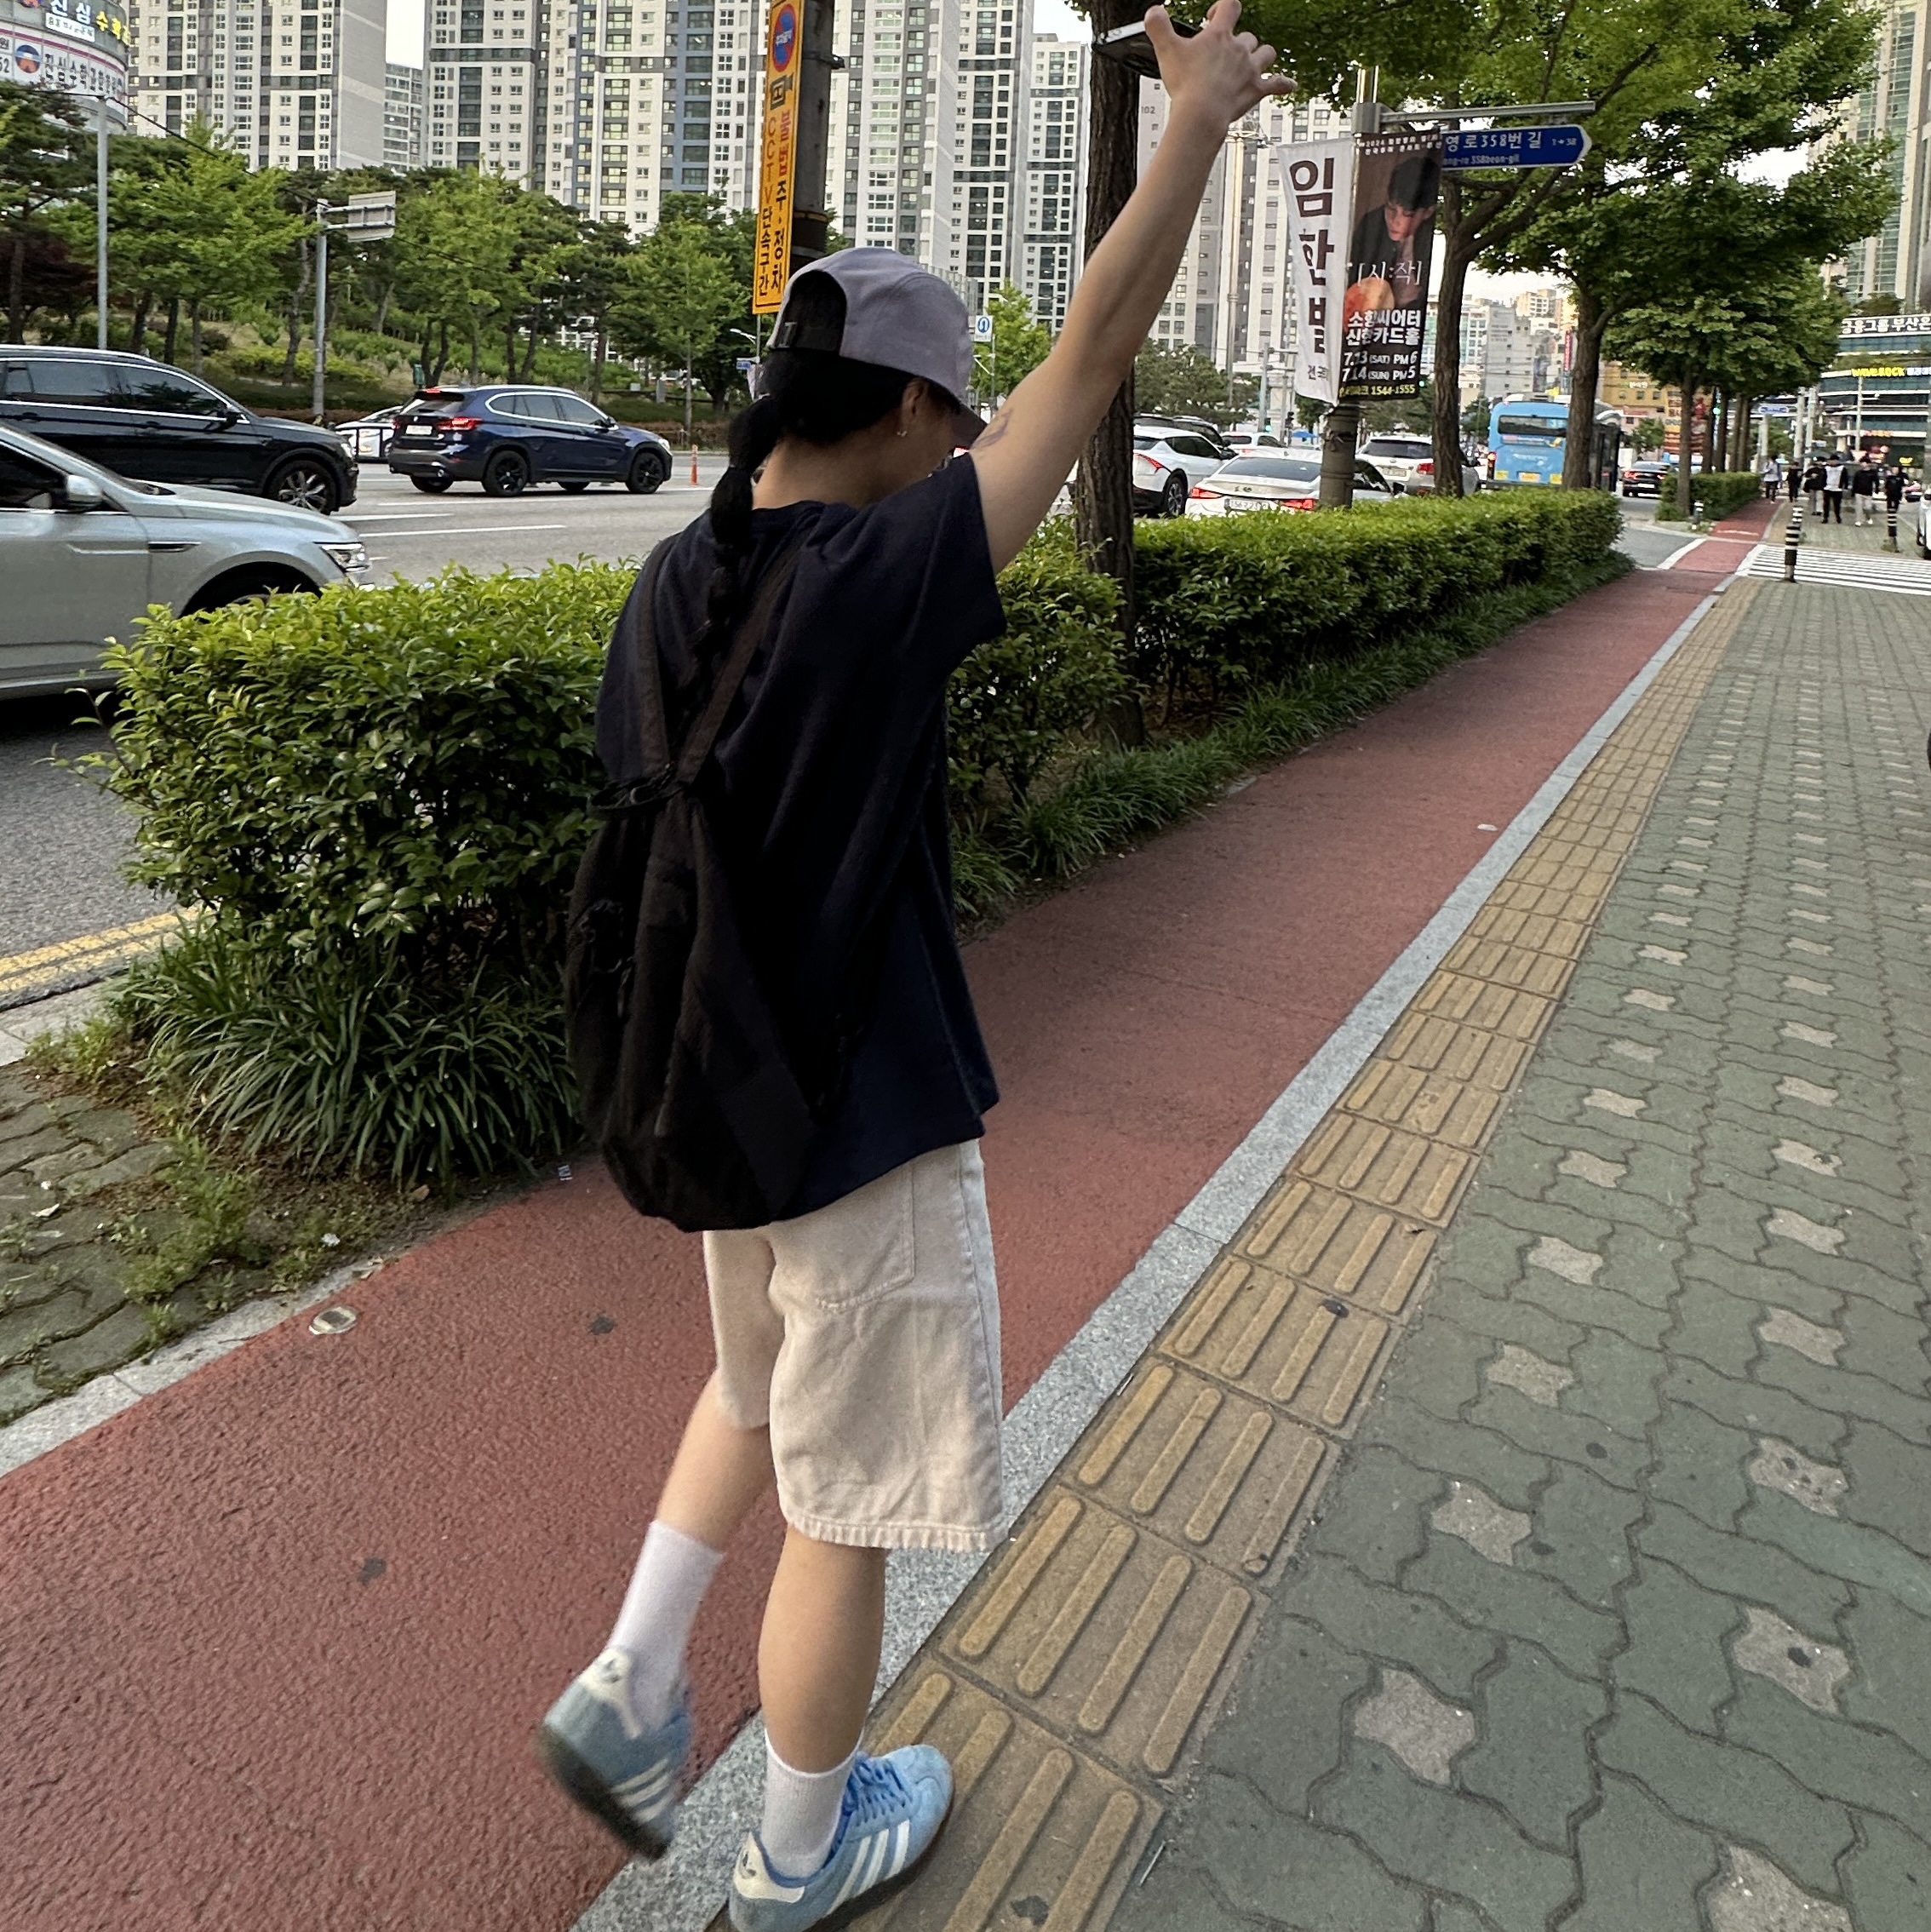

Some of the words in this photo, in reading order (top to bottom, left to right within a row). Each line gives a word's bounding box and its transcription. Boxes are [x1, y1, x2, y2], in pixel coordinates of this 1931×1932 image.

[1141, 106, 1155, 114] 102
[1446, 131, 1542, 152] 영로358번길
[1348, 309, 1421, 327] 소향씨어터
[1346, 327, 1420, 346] 신한카드홀
[1344, 351, 1367, 366] 7.13
[1369, 354, 1390, 364] (SAT)
[1371, 384, 1415, 395] 1544-1555
